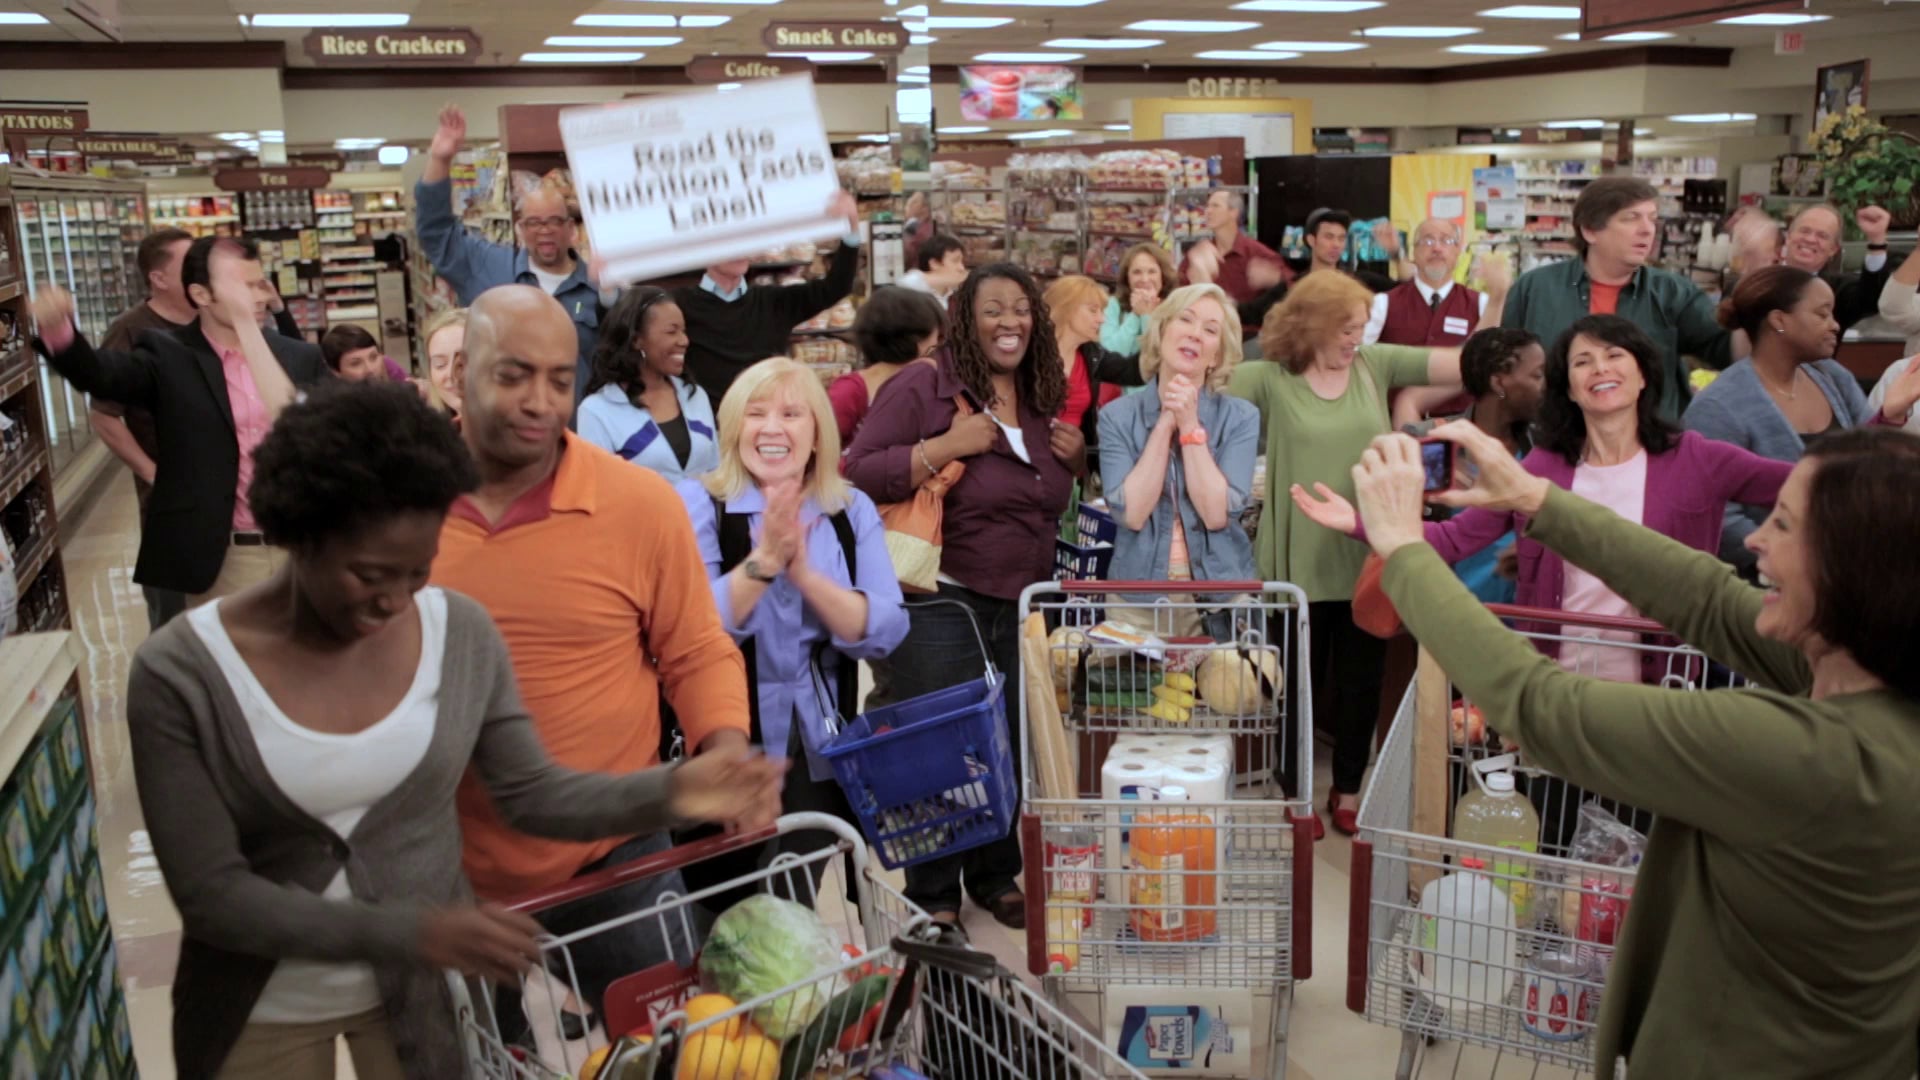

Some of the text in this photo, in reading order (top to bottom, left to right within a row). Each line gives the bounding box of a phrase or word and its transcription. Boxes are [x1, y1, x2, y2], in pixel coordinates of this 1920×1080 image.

[321, 35, 466, 55] Rice Crackers
[776, 27, 898, 46] Snack Cakes
[724, 62, 781, 77] Coffee
[1187, 77, 1280, 98] COFFEE
[77, 141, 158, 154] VEGETABLES
[633, 128, 775, 172] Read the
[587, 149, 826, 214] Nutrition Facts
[668, 184, 767, 231] Label!
[1158, 1023, 1171, 1052] Paper
[1172, 1017, 1185, 1057] Towels
